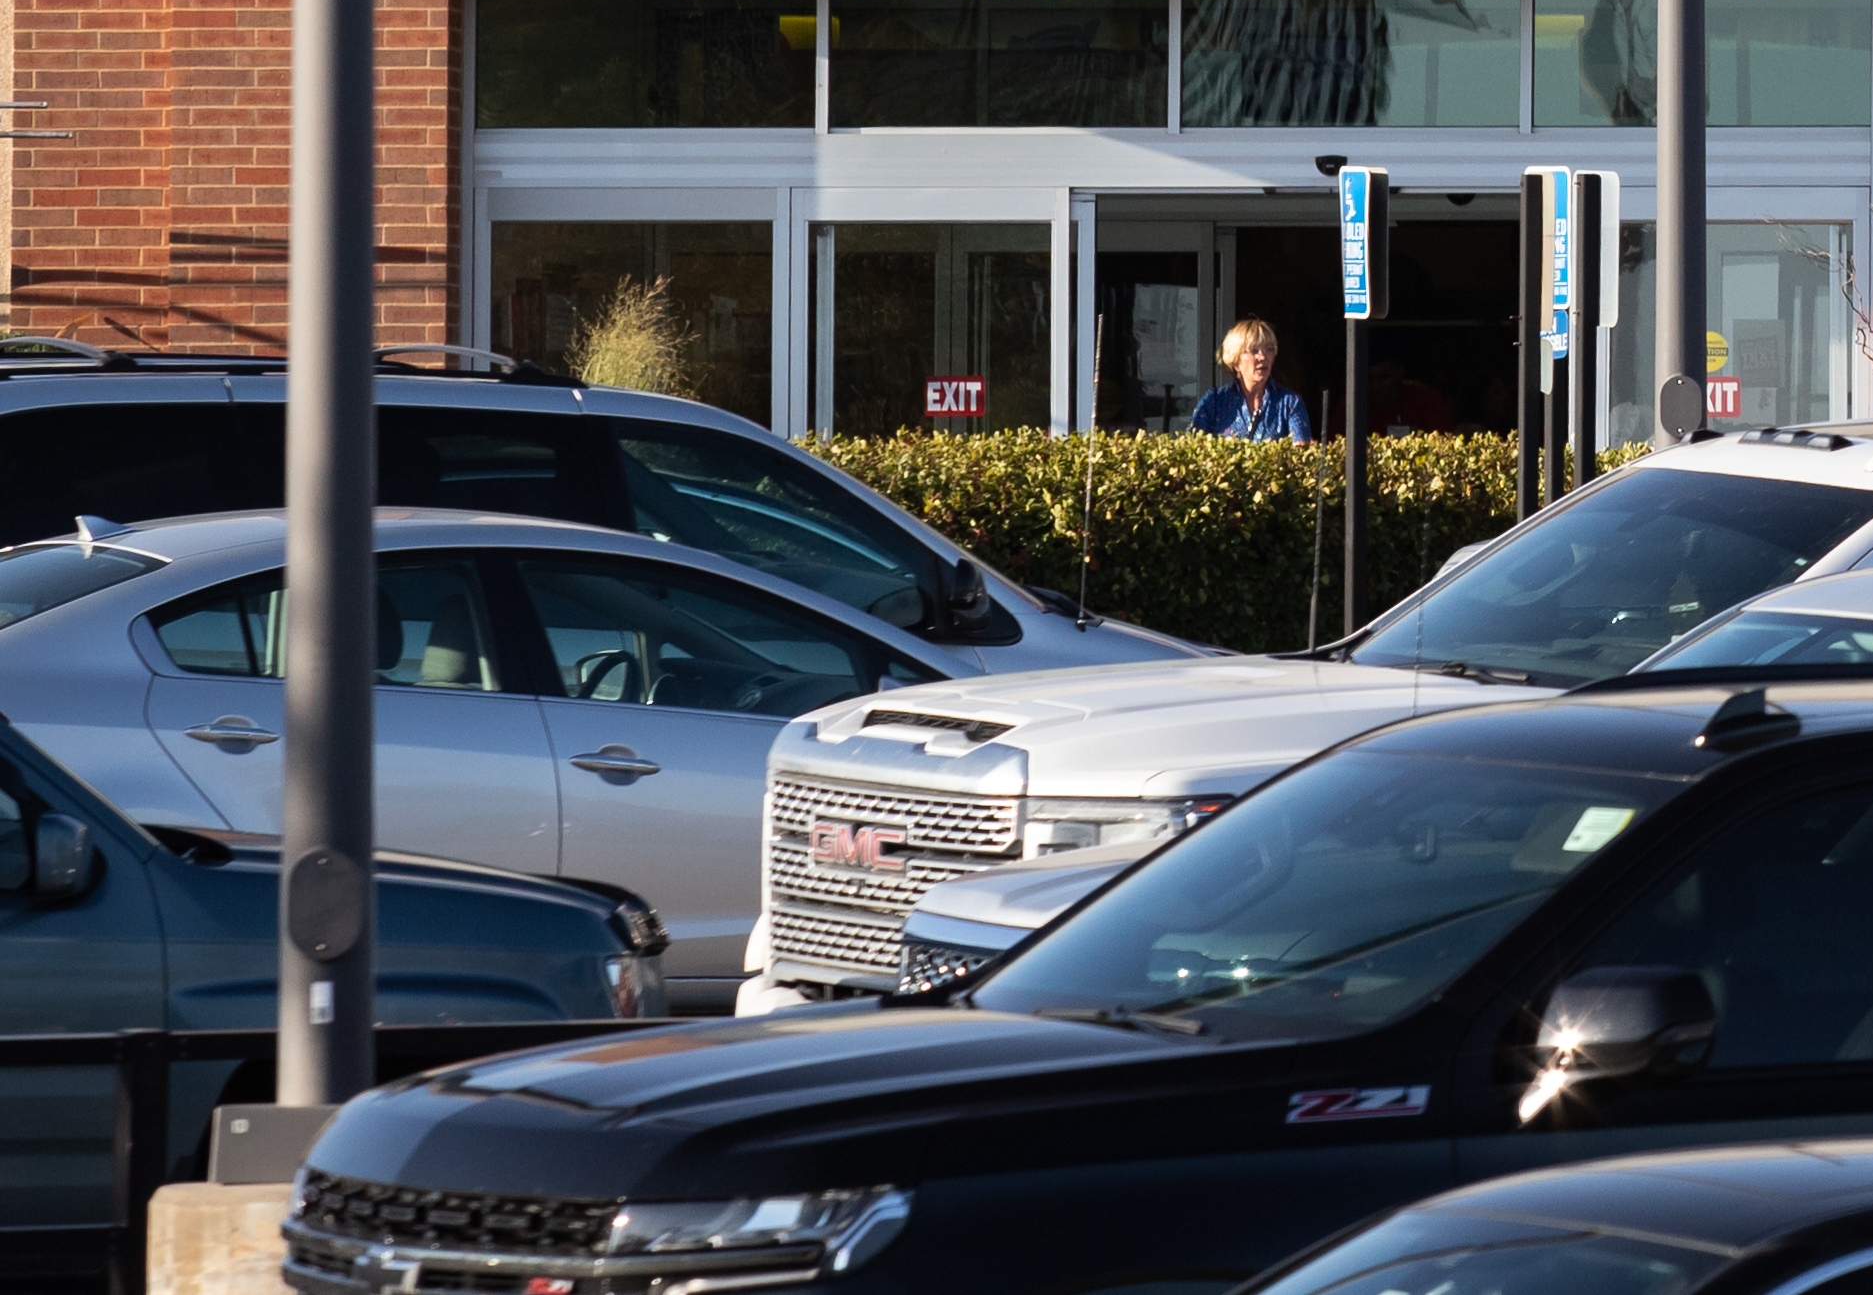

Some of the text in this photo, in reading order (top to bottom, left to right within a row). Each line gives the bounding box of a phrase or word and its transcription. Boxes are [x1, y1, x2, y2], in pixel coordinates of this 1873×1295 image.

[1343, 221, 1364, 240] BLED
[1707, 348, 1727, 356] TION
[927, 381, 982, 412] EXIT
[1706, 382, 1739, 413] XIT
[809, 821, 906, 870] GMC
[1285, 1084, 1431, 1124] Z71
